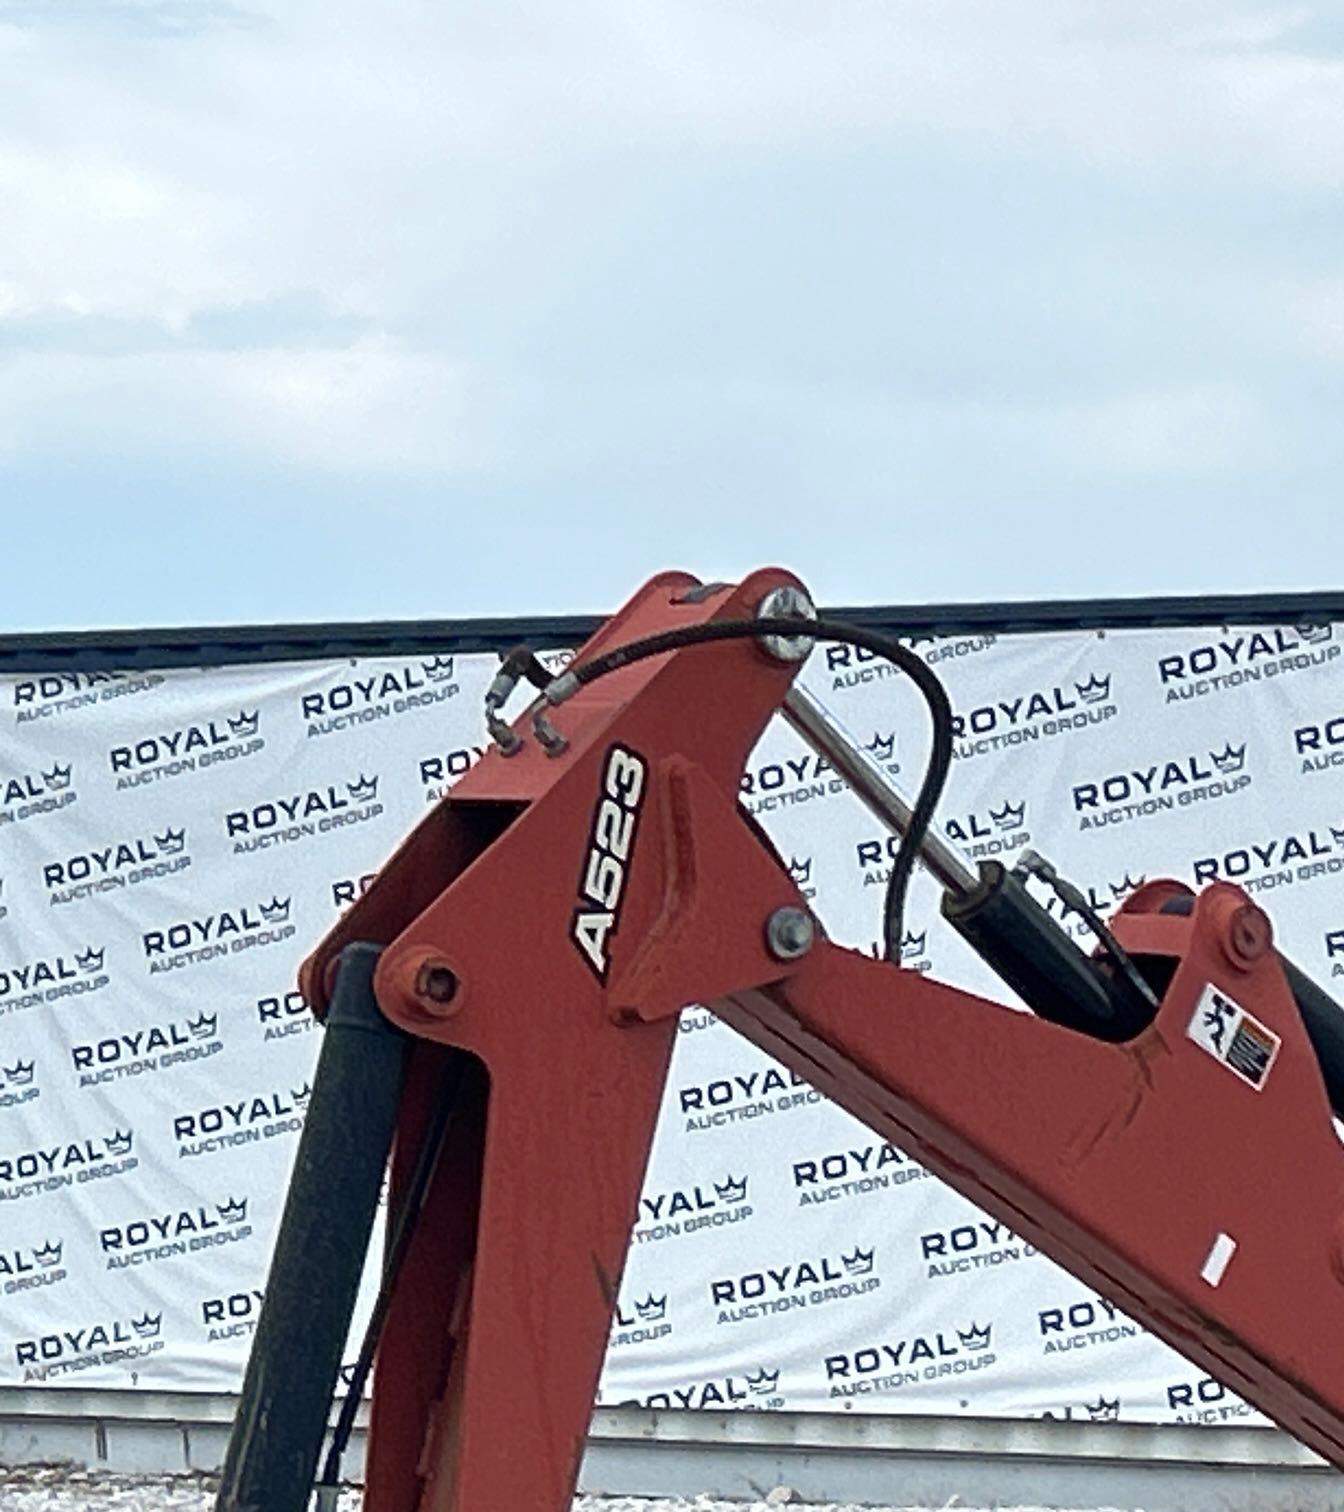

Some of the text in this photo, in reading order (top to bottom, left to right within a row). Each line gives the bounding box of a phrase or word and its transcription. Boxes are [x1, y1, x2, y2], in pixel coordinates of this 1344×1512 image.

[1159, 628, 1299, 682] ROYAL
[1165, 645, 1340, 703] AUCTION GROUP
[303, 668, 423, 718] ROYAL
[308, 684, 459, 738] AUCTION GROUP
[1043, 706, 1115, 736] GROUP
[111, 722, 227, 771] ROYAL
[116, 738, 262, 791] AUCTION GROUP
[17, 791, 78, 819] GROUP
[1074, 758, 1212, 810] ROYAL
[1080, 775, 1252, 831] AUCTION GROUP
[228, 787, 347, 836] ROYAL
[234, 803, 383, 856] AUCTION GROUP
[42, 840, 158, 888] ROYAL
[48, 856, 192, 907] AUCTION GROUP
[573, 747, 646, 974] A523
[1192, 833, 1333, 884] ROYAL
[143, 908, 261, 955] ROYAL
[149, 924, 295, 975] AUCTION GROUP
[48, 973, 109, 1000] GROUP
[73, 1024, 189, 1070] ROYAL
[78, 1040, 223, 1089] AUCTION GROUP
[174, 1094, 292, 1139] ROYAL
[685, 1100, 772, 1132] AUCTION
[179, 1128, 259, 1159] AUCTION
[78, 1156, 139, 1182] GROUP
[799, 1175, 888, 1207] AUCTION
[101, 1207, 218, 1252] ROYAL
[684, 1205, 752, 1232] GROUP
[106, 1224, 252, 1271] AUCTION GROUP
[927, 1247, 1017, 1279] AUCTION
[5, 1268, 66, 1294] GROUP
[712, 1259, 841, 1304] ROYAL
[717, 1277, 879, 1325] AUCTION GROUP
[16, 1322, 131, 1365] ROYAL
[825, 1334, 957, 1380] ROYAL
[1043, 1324, 1136, 1355] AUCTION
[830, 1353, 996, 1400] AUCTION GROUP
